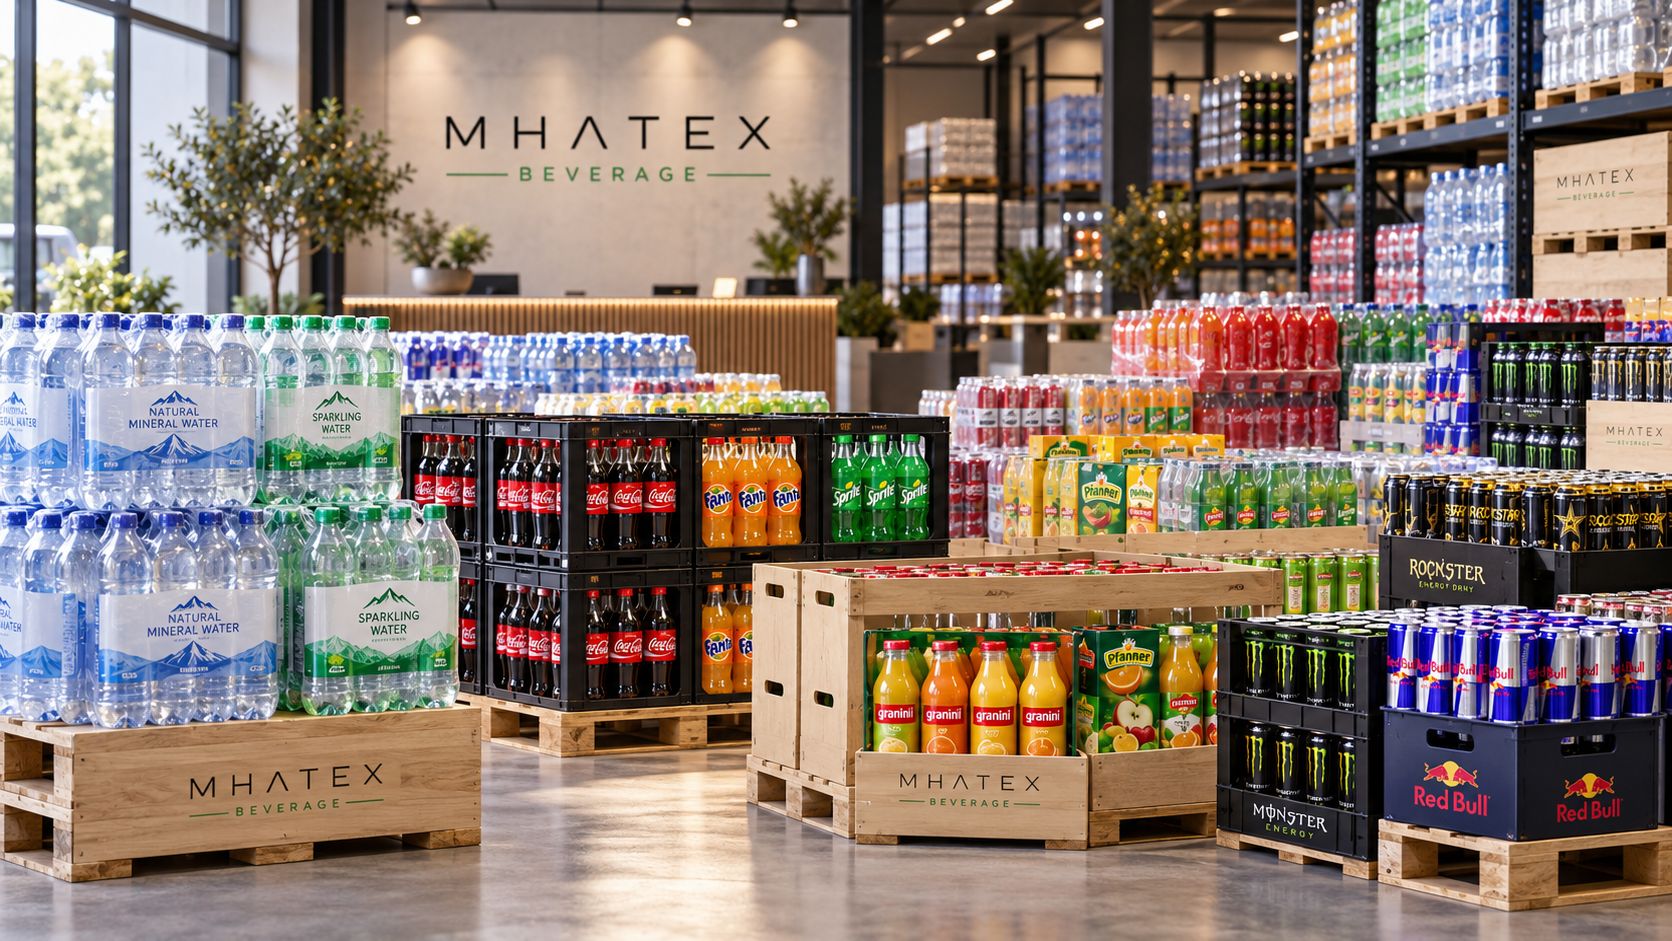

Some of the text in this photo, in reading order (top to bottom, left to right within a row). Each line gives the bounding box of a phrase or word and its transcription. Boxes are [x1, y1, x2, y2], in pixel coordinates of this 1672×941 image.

[446, 116, 771, 150] MHATEX
[519, 166, 696, 182] BEVERAGE
[1557, 168, 1634, 188] MHATEX
[149, 407, 199, 416] NATURAL
[312, 412, 362, 422] SPARKLING
[128, 418, 218, 429] MINERAL WATER
[321, 424, 351, 434] WATER
[1606, 426, 1663, 437] MHATEX
[832, 484, 860, 507] Sprite
[866, 484, 895, 507] Sprite
[900, 483, 928, 504] Sprite
[168, 612, 221, 623] NATURAL
[358, 610, 420, 623] SPARKLING
[147, 622, 240, 638] MINERAL WATER
[371, 624, 407, 636] WATER
[1494, 668, 1514, 680] Bull
[1546, 666, 1567, 679] Bull
[976, 709, 1011, 723] granini
[1025, 710, 1060, 723] granini
[190, 763, 383, 799] MHATEX
[899, 773, 1040, 791] MHATEX
[235, 799, 340, 816] BEVERAGE
[929, 798, 1009, 808] BEVERAGE
[1414, 785, 1488, 816] Red Bull
[1556, 798, 1621, 823] Red Bull
